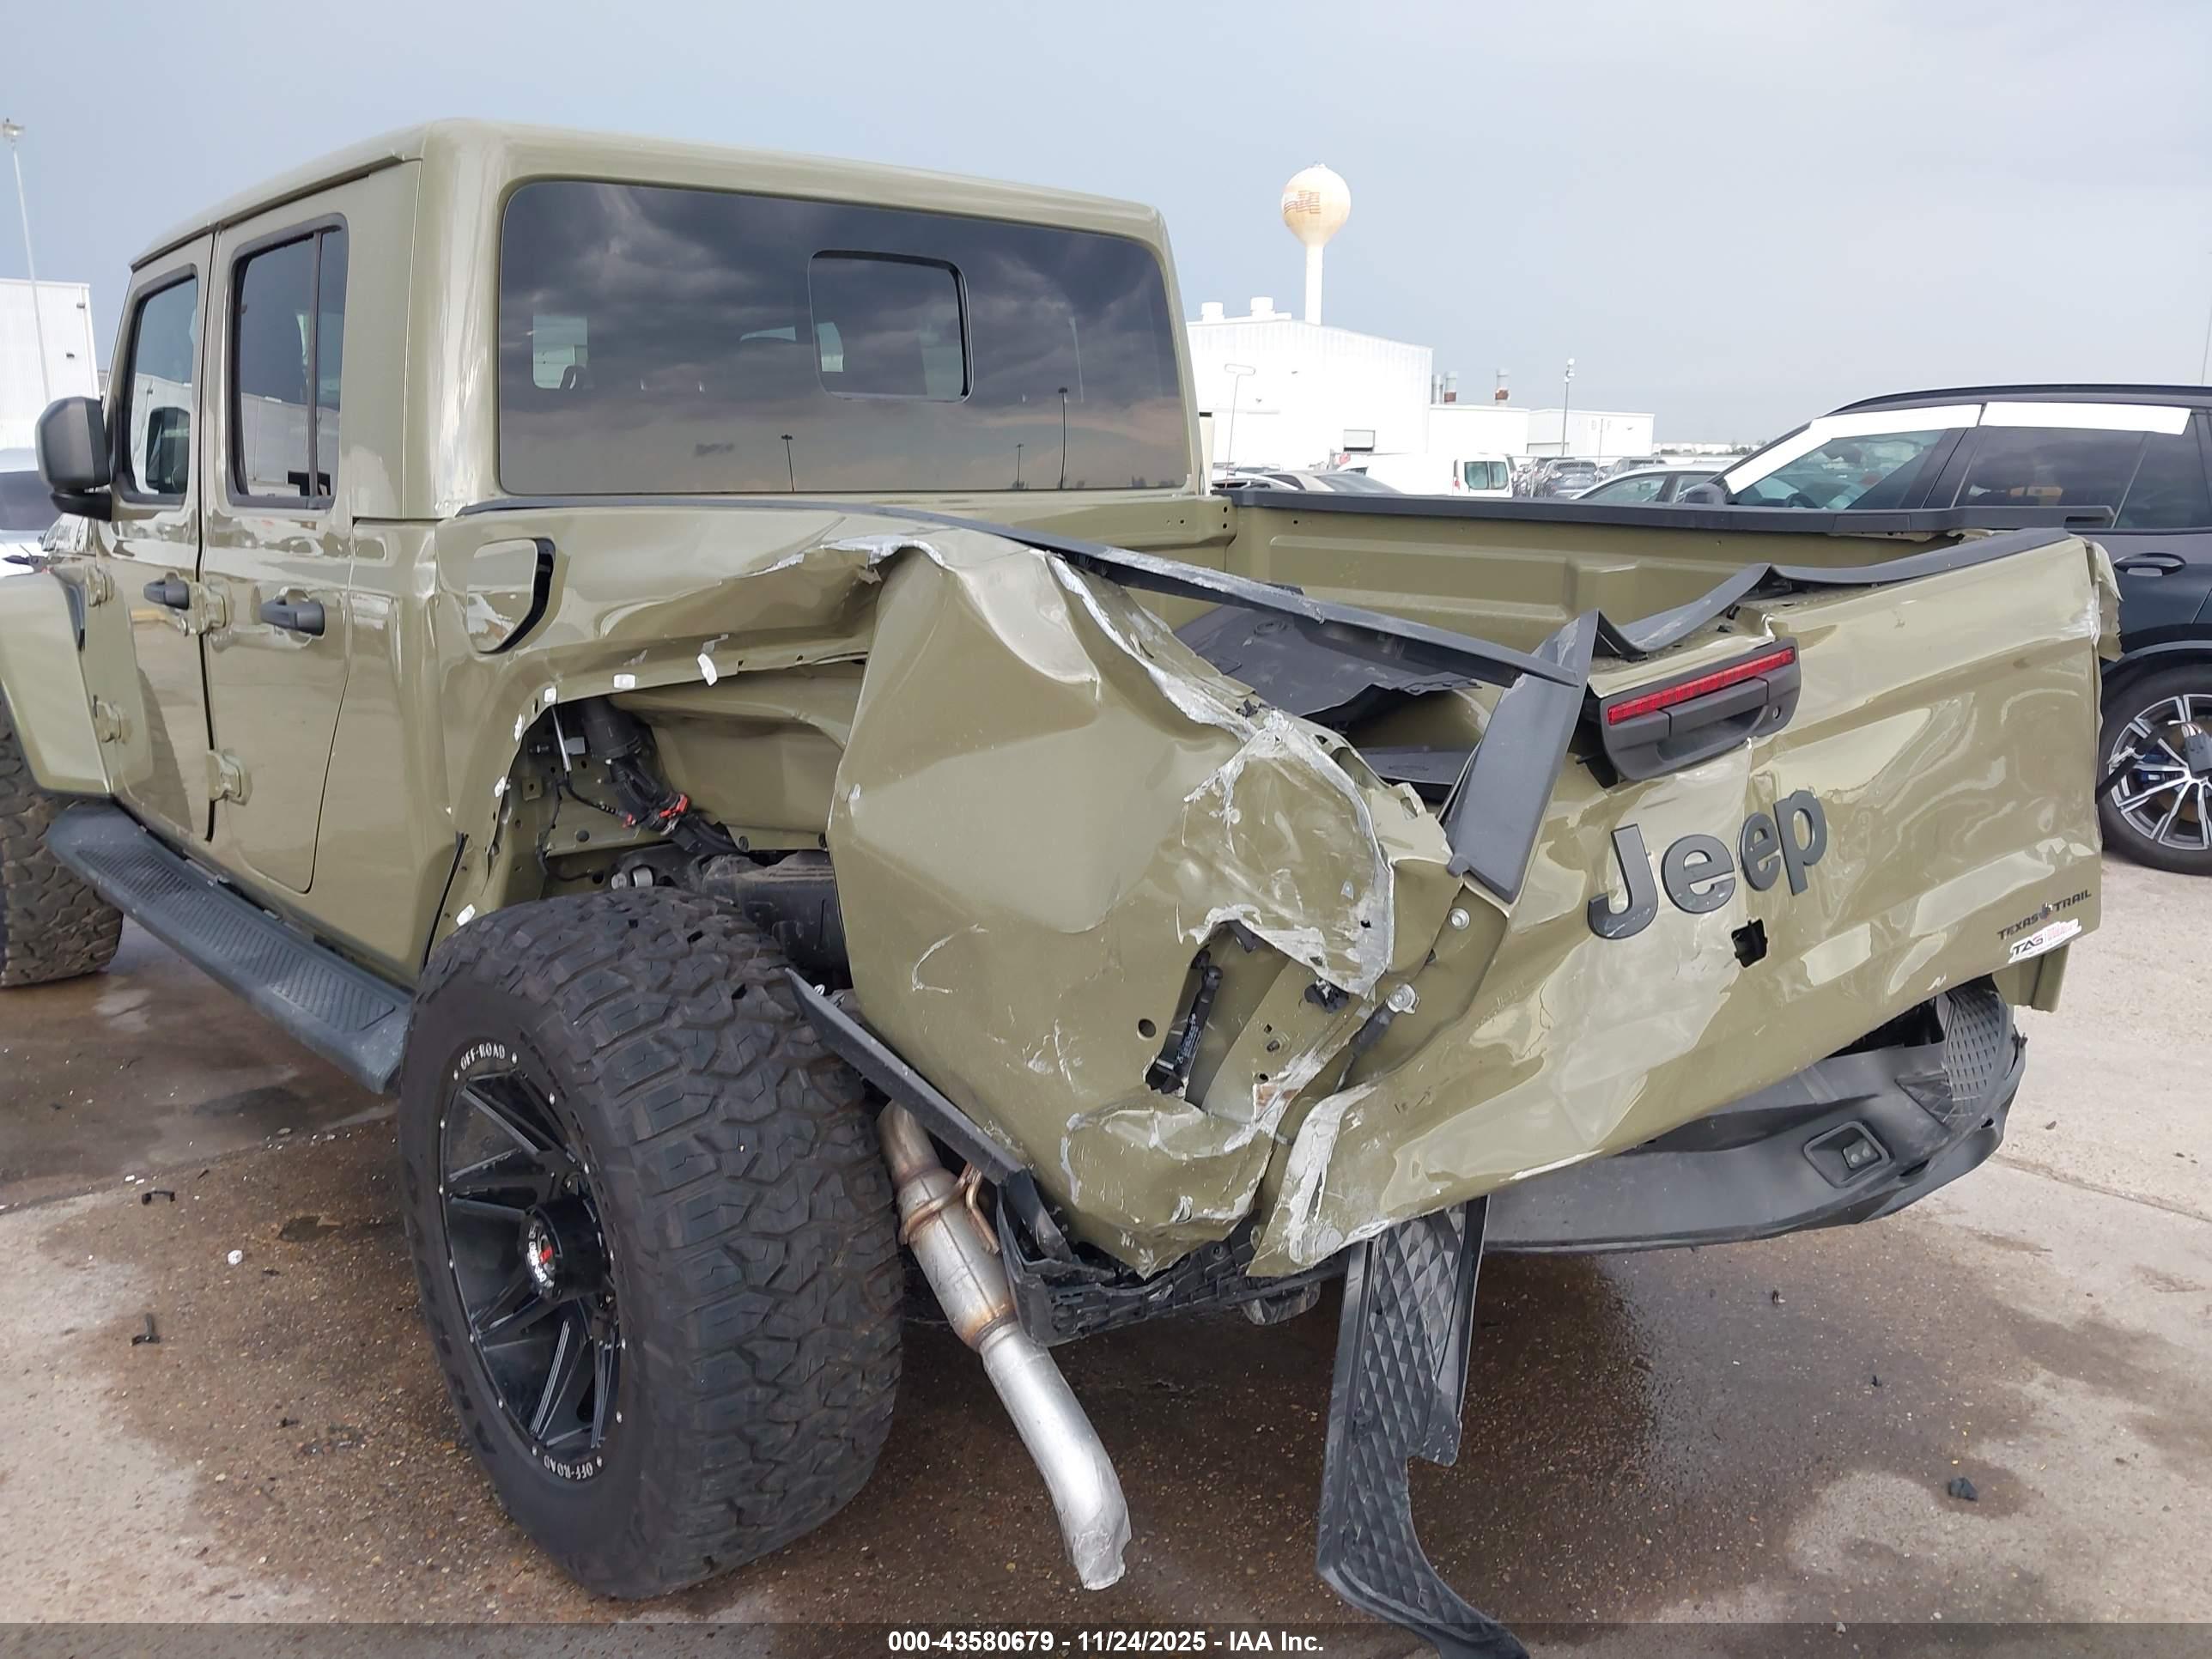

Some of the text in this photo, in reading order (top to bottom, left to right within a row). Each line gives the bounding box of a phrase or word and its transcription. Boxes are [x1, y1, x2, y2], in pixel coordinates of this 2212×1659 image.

[1587, 788, 1828, 939] Jeep
[1996, 911, 2039, 940] TEXAS
[2053, 889, 2093, 912] TRAIL
[460, 1042, 506, 1071] OFF-ROAD
[543, 1455, 593, 1480] OFF-ROAD
